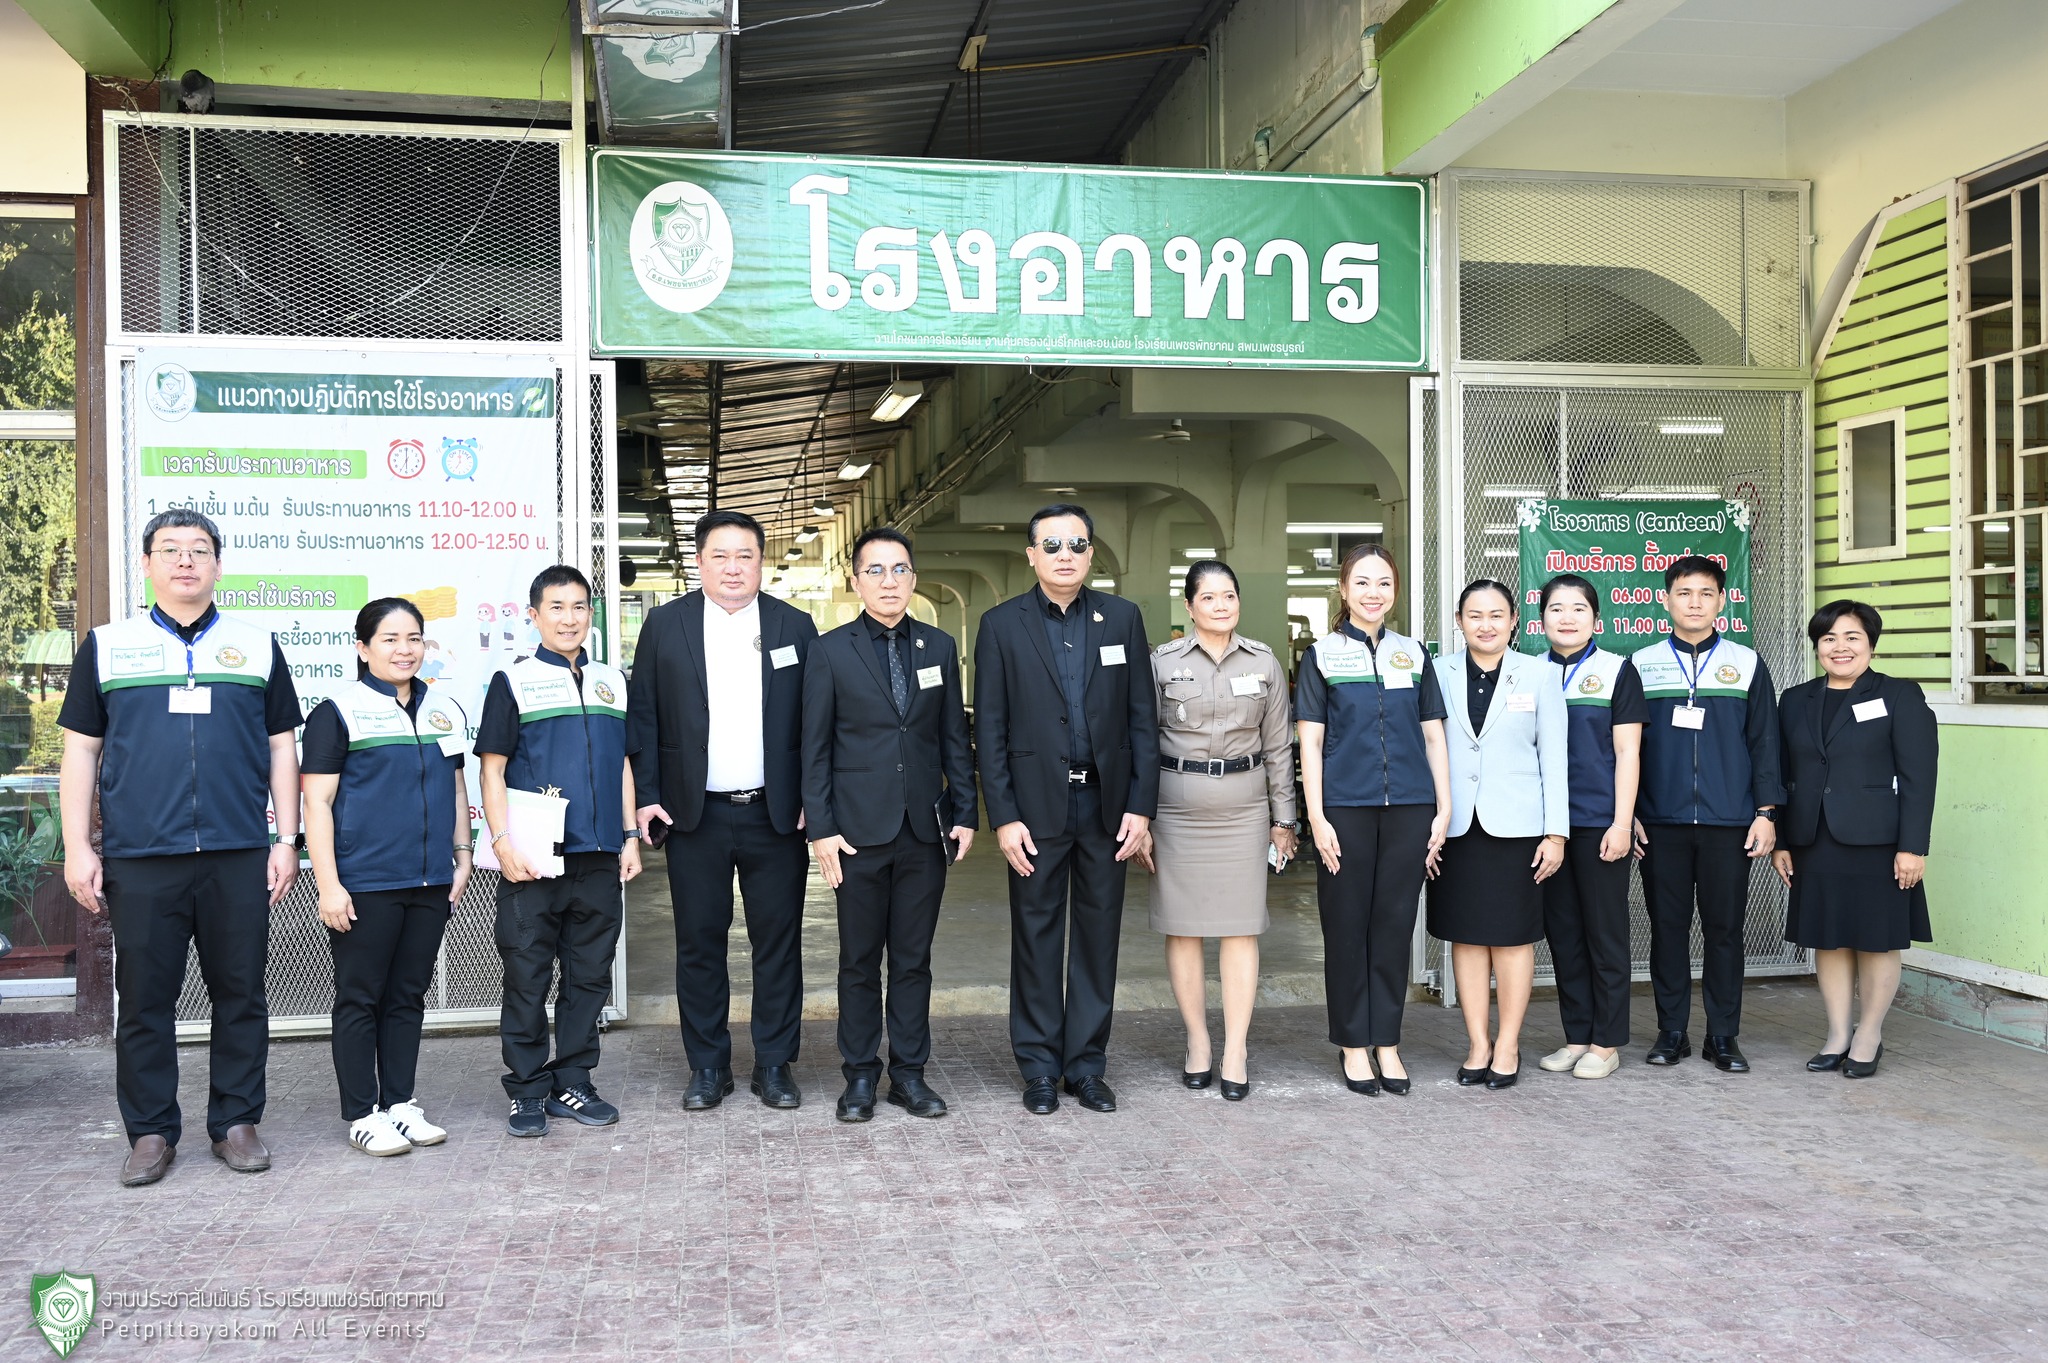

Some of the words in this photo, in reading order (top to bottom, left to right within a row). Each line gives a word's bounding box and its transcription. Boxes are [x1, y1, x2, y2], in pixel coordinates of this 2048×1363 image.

[789, 174, 1380, 324] โรงอาหาร
[1134, 335, 1234, 351] โรงเรียนเพชรพิทยาคม
[1237, 340, 1305, 356] สพม.เพชรบูรณ์
[217, 378, 514, 415] แนวทางปฏิบัติการใช้โรงอาหาร
[162, 449, 352, 476] เวลารับประทานอาหาร
[234, 496, 270, 517] ม.ต้น
[283, 496, 411, 518] รับประทานอาหาร
[418, 500, 517, 518] 11.10-12.00
[523, 503, 537, 518] น.
[1548, 506, 1630, 533] โรงอาหาร
[1636, 511, 1726, 533] (Canteen)
[234, 531, 289, 549] ม.ปลาย
[297, 529, 424, 550] รับประทานอาหาร
[431, 532, 529, 550] 12.00-12.50
[536, 535, 549, 550] น.
[1545, 547, 1636, 573] เปิดบริการ
[213, 580, 337, 608] นการใช้บริการ
[1610, 587, 1653, 604] 06.00
[1613, 617, 1654, 635] 11.00
[1657, 618, 1673, 635] น.
